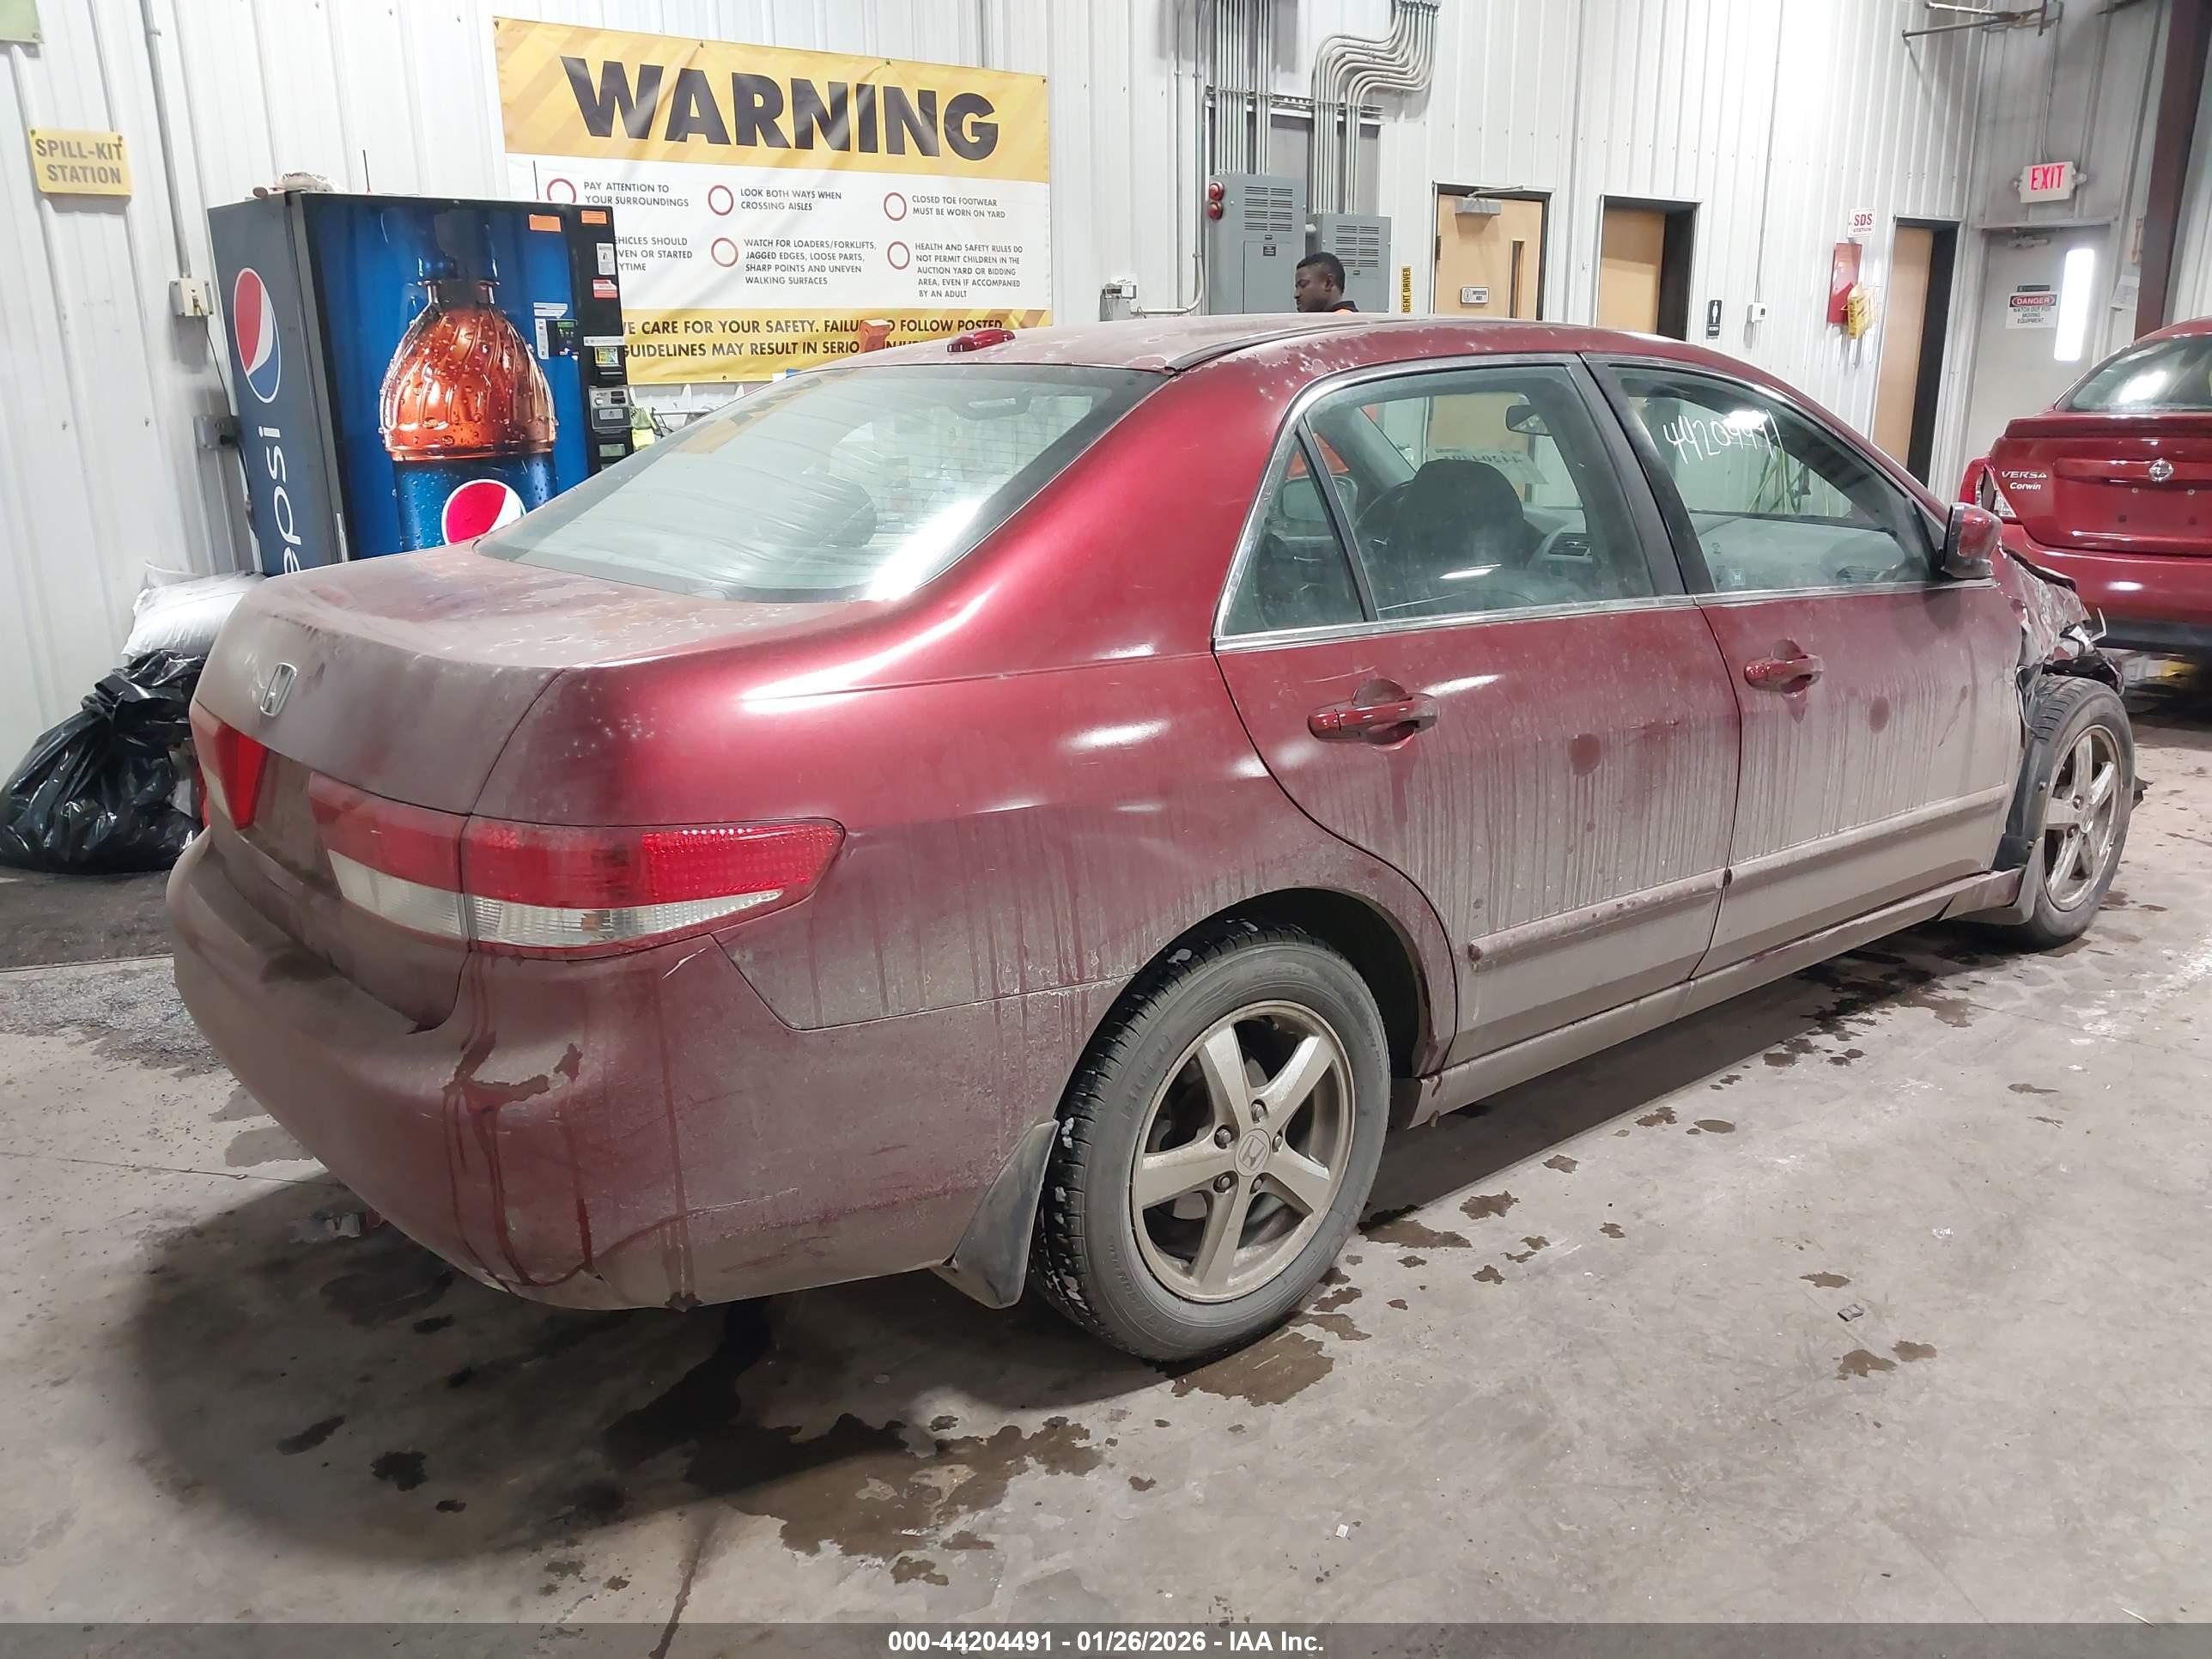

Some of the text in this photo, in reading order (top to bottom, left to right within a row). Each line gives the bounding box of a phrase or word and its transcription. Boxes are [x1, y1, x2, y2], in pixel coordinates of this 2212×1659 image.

[560, 56, 1000, 161] WARNING
[35, 138, 123, 161] SPILL-KIT
[46, 164, 122, 185] STATION
[2031, 164, 2065, 191] EXIT
[584, 181, 669, 193] PAY ATTENTION TO
[740, 188, 842, 200] LOOK BOTH WAYS WHEN
[585, 195, 689, 207] YOUR SURROUNDINGS
[740, 201, 812, 210] CROSSING AISLES
[912, 195, 997, 206] CLOSED TOE FOOTWEAR
[913, 207, 933, 216] MUST
[946, 209, 971, 217] WORN
[1854, 213, 1872, 226] SDS
[651, 237, 688, 246] SHOULD
[744, 239, 773, 247] WATCH
[793, 240, 877, 250] LOADERS/FORKLIFTS,
[915, 242, 943, 251] HEALTH
[945, 243, 962, 252] AND
[964, 244, 989, 252] SAFETY
[992, 245, 1012, 253] RULES
[658, 250, 693, 258] STARTED
[745, 251, 865, 262] JAGGED EDGES, LOOSE PARTS,
[745, 264, 772, 272] SHARP
[807, 264, 826, 273] AND
[918, 278, 939, 287] AREA,
[1402, 267, 1411, 293] DRIVER
[624, 321, 635, 334] E
[641, 321, 678, 334] CARE
[684, 320, 714, 333] FOR
[718, 320, 761, 333] YOUR
[766, 319, 819, 333] SAFETY.
[824, 319, 862, 332] FAILU
[900, 319, 953, 332] FOLLOW
[957, 319, 1003, 332] POSTED
[624, 343, 706, 357] GUIDELINES
[712, 343, 744, 356] MAY
[750, 342, 798, 356] RESULT
[802, 341, 817, 355] IN
[2009, 482, 2041, 490] Corwin
